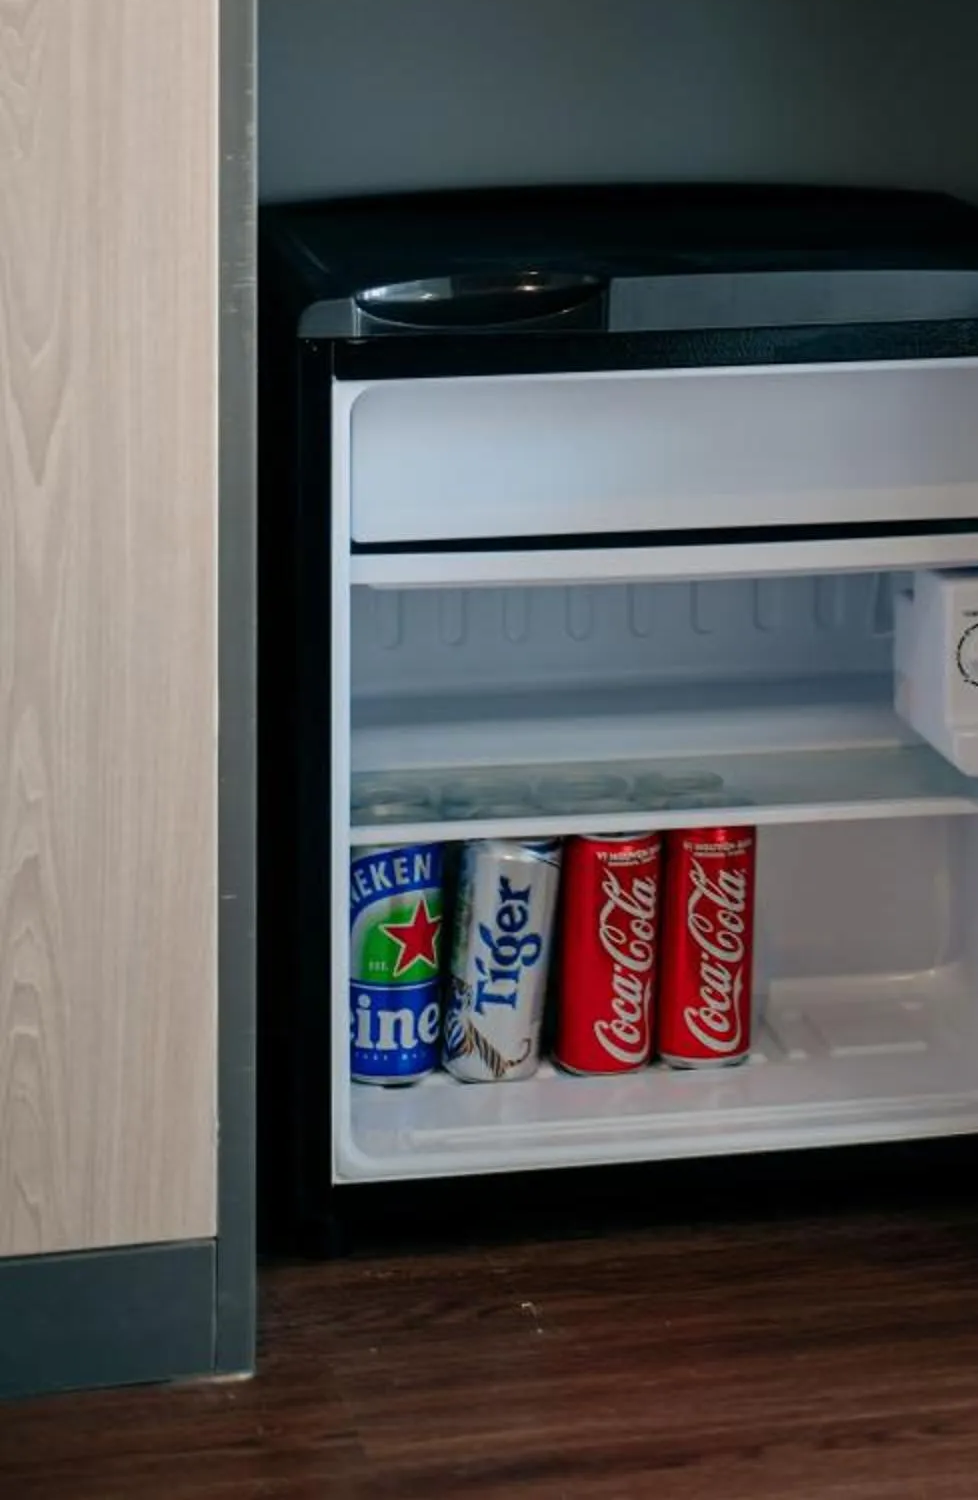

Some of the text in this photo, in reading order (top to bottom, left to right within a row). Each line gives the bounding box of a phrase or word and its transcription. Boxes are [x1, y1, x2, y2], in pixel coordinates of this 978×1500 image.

[352, 852, 432, 902] EKEN
[474, 875, 543, 1016] Tiger
[683, 856, 748, 1052] Coca-Cola
